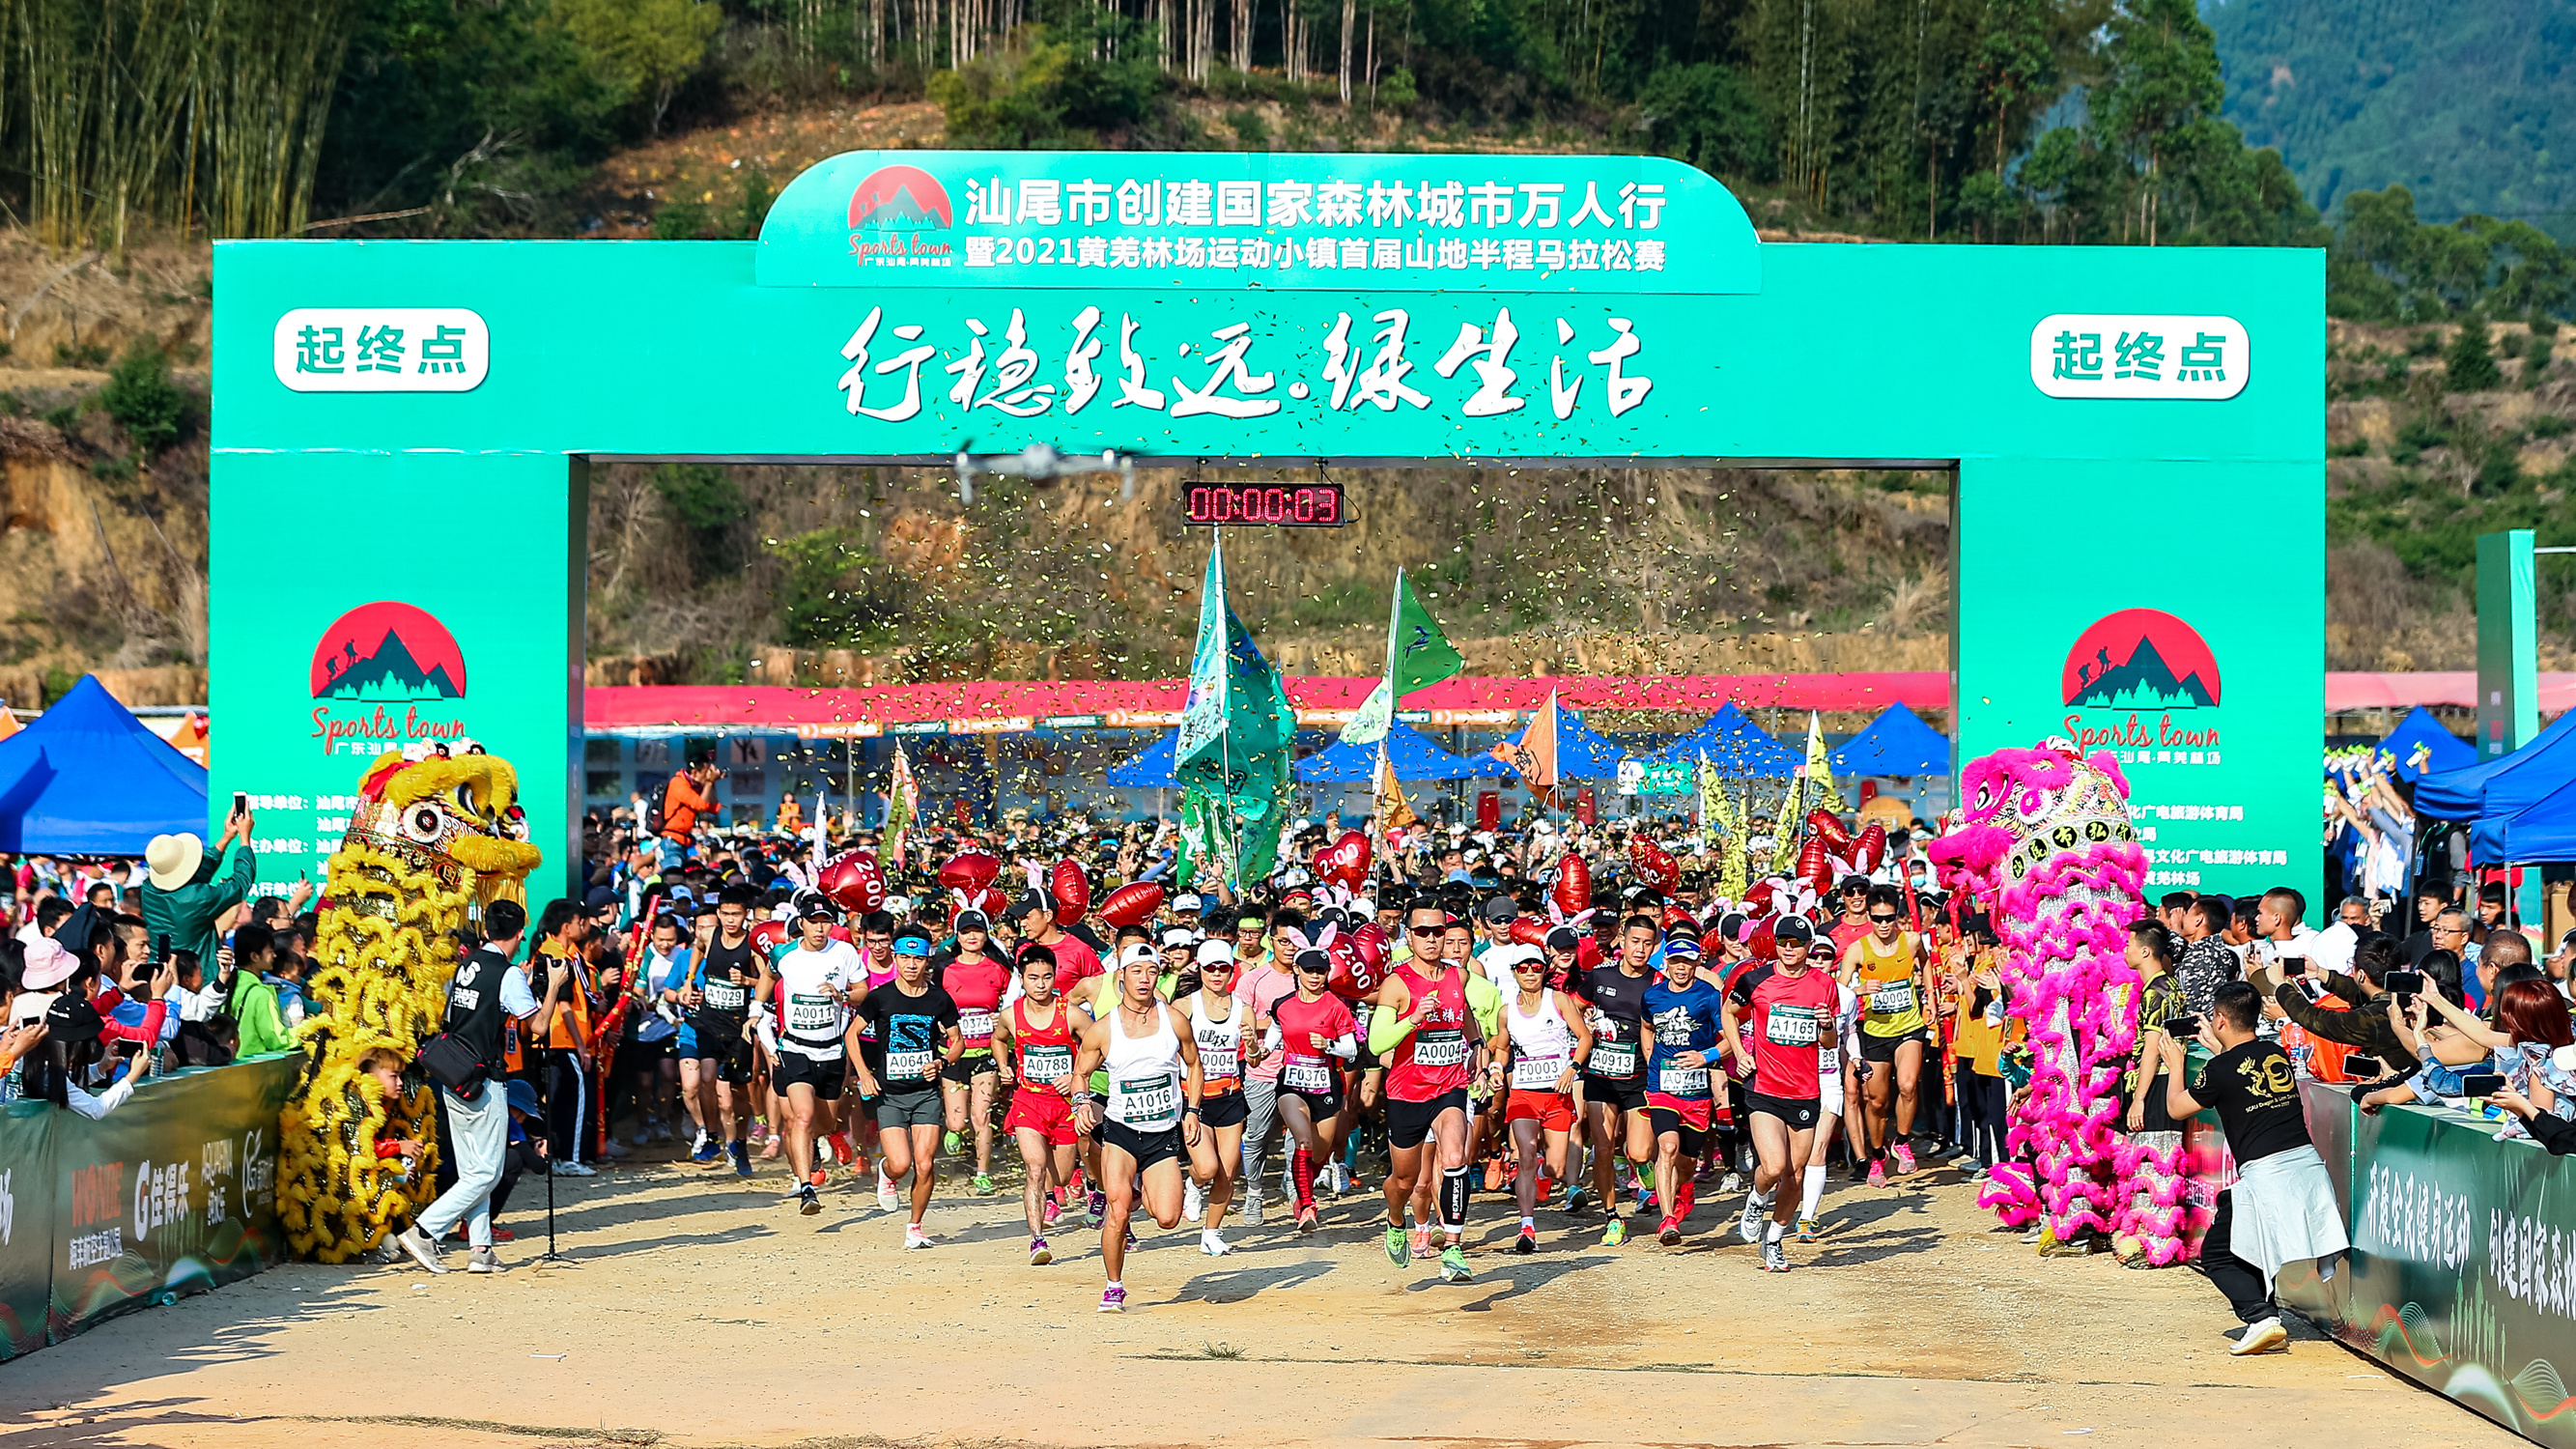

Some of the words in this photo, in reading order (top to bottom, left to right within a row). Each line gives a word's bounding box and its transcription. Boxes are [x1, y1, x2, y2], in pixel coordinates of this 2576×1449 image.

[964, 176, 1667, 229] 汕尾市创建国家森林城市万人行
[848, 233, 908, 267] Sports
[911, 234, 952, 256] town
[296, 325, 467, 375] 起终点
[2052, 330, 2227, 383] 起终点
[1189, 486, 1337, 523] 00:00:03
[311, 705, 401, 756] Sports
[405, 705, 467, 739] town
[2063, 713, 2154, 759] Sports
[2159, 713, 2221, 747] town
[1318, 842, 1360, 877] 2:00
[853, 859, 883, 907] 2:00
[1336, 943, 1373, 990] 2:00
[706, 988, 742, 1002] A1029
[1873, 990, 1911, 1006] A0002
[793, 1006, 833, 1019] A0011
[1770, 1018, 1815, 1035] A1165
[890, 1053, 931, 1068] A0643
[1027, 1057, 1069, 1072] A0788
[1200, 1053, 1234, 1066] 0004
[1417, 1043, 1461, 1060] A0004
[1592, 1051, 1632, 1068] A0913
[1288, 1067, 1327, 1082] F0376
[1518, 1061, 1559, 1076] F0003
[1124, 1089, 1171, 1110] A1016
[151, 1160, 190, 1230] 佳得乐
[2366, 1160, 2472, 1277] 开展全民健身运动
